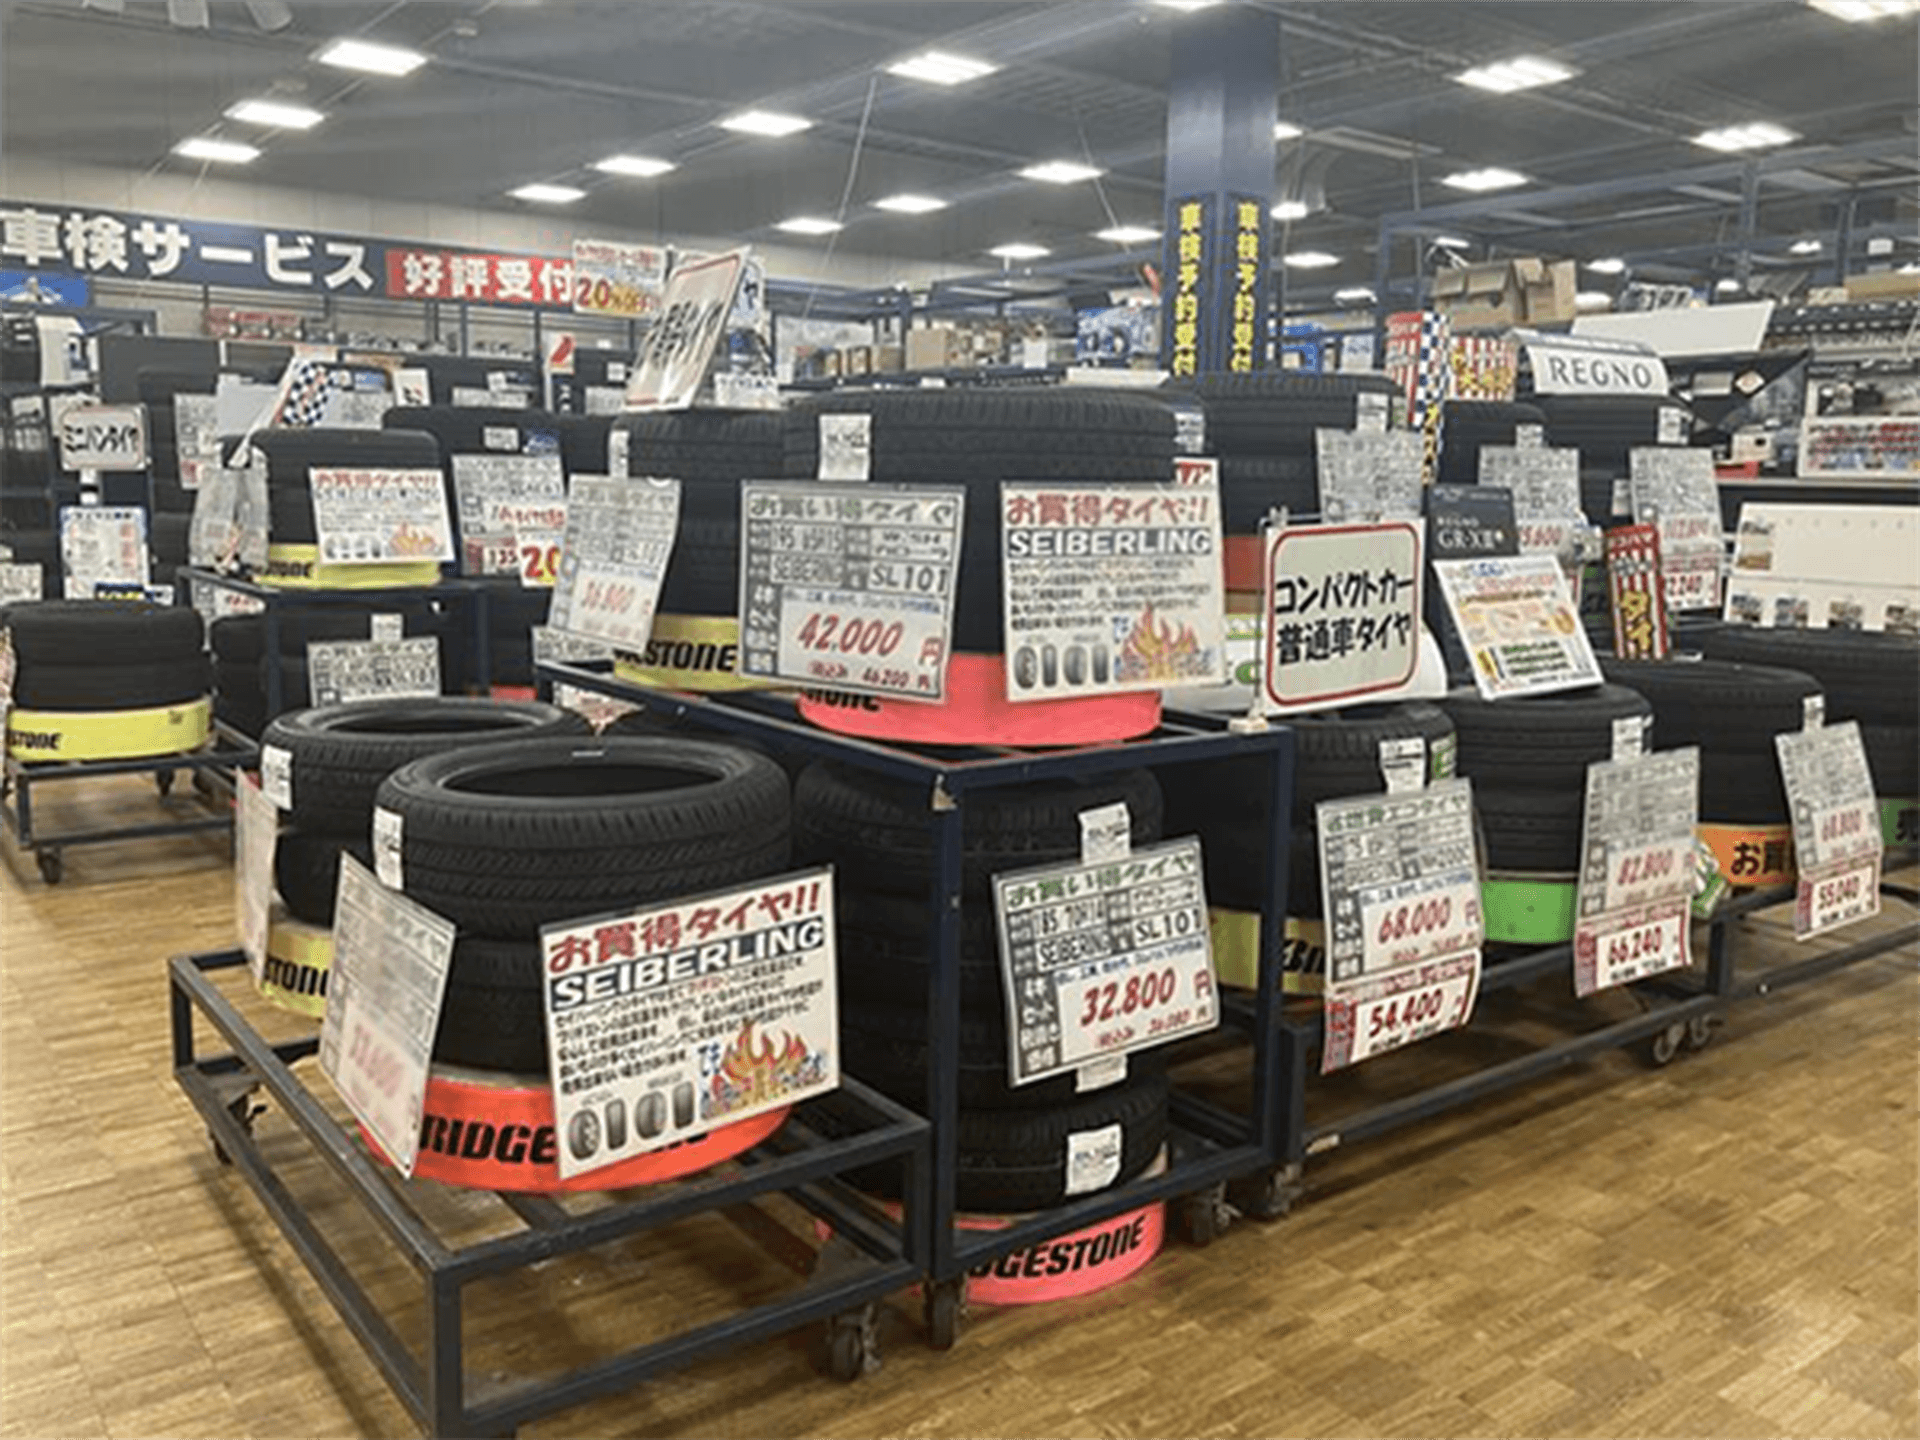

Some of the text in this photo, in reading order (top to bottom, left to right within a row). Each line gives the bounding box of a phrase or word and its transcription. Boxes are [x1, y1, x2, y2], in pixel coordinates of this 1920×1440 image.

[0, 207, 375, 292] 車検サービス
[402, 252, 575, 303] 好評受付
[1549, 356, 1651, 388] REGNO
[1009, 529, 1211, 557] SEIBERLING
[1276, 567, 1415, 614] コンパクトカー
[1277, 611, 1412, 666] 普通車タイヤ
[548, 881, 820, 974] お買得タイヤ!!
[553, 919, 823, 1009] SEIBERLING
[420, 1112, 557, 1166] RIDGE
